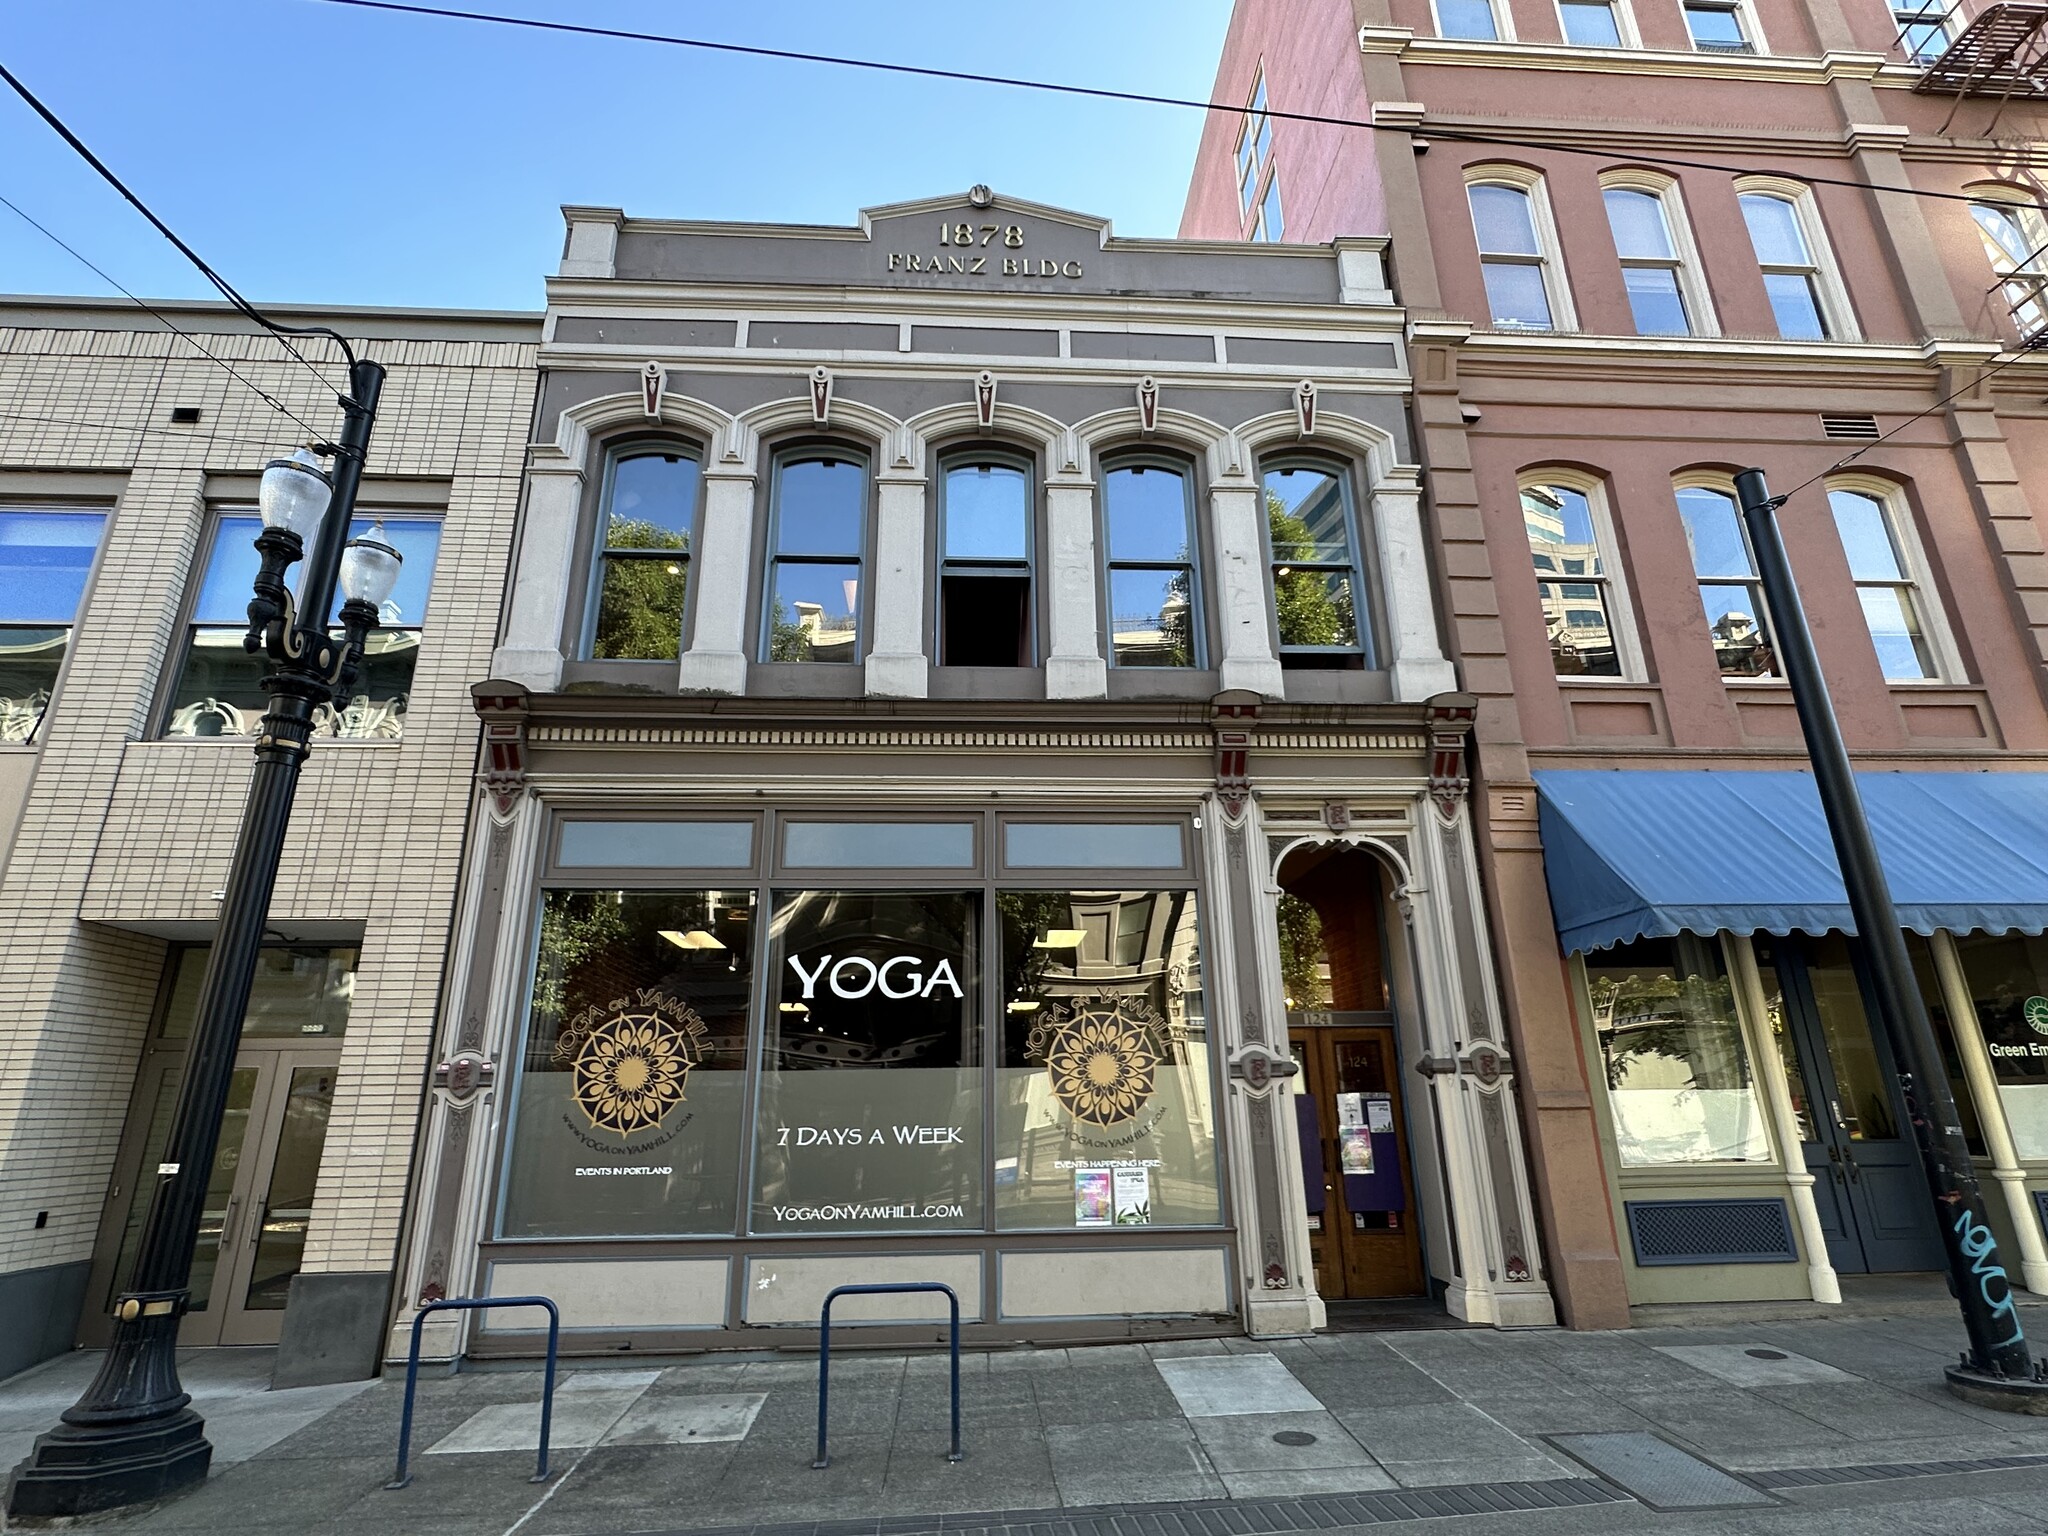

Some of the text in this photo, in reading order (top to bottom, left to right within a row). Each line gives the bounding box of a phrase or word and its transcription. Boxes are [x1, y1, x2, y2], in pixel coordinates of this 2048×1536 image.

[939, 222, 1024, 249] 1878
[887, 253, 1083, 278] FRANZ BLDG
[787, 954, 965, 999] YOGA
[551, 1005, 606, 1062] YOGA
[636, 988, 714, 1062] YAMHILL
[1023, 1002, 1070, 1059] YOGA
[1096, 986, 1174, 1057] YAMHILL
[1307, 1013, 1328, 1025] 124
[1989, 1042, 2029, 1057] Green
[777, 1125, 964, 1146] 7 DAYS A WEEK
[575, 1166, 673, 1176] EVENTS IN PORTLAND
[1054, 1159, 1161, 1169] EVENTS HAPPENING HERE
